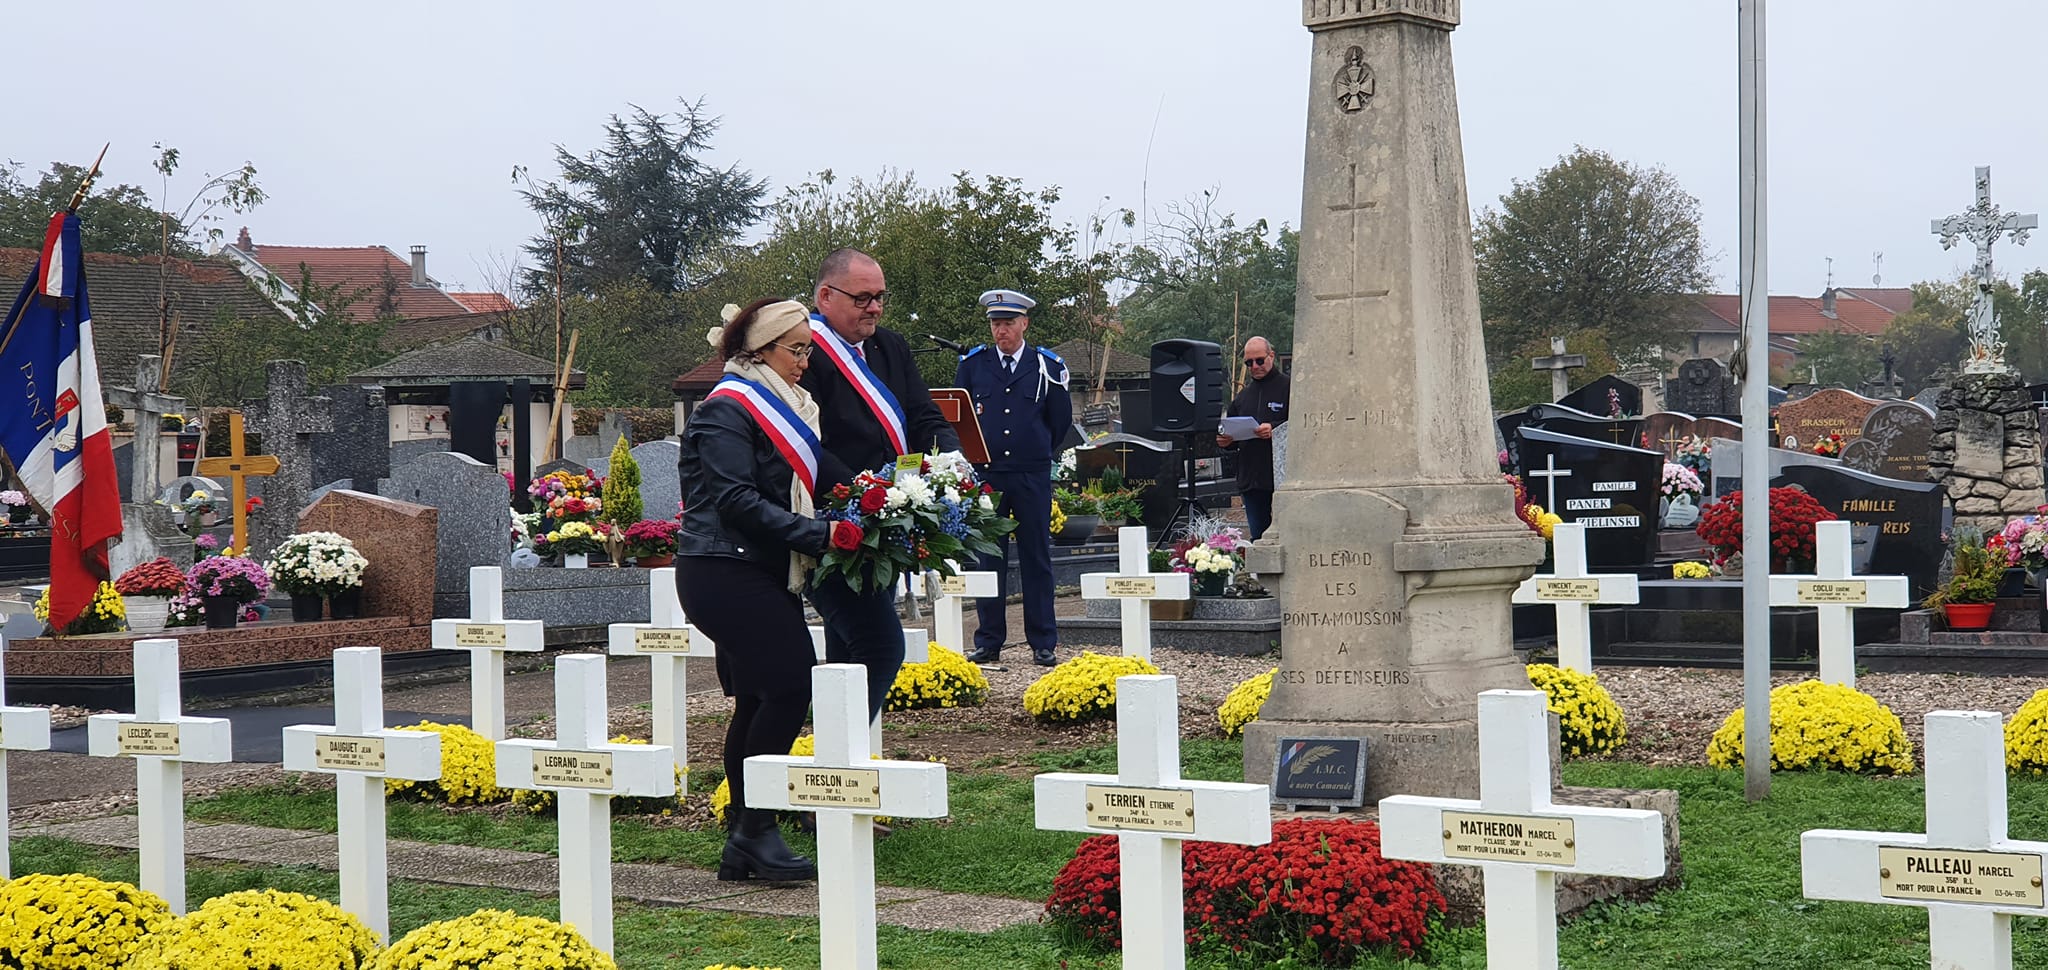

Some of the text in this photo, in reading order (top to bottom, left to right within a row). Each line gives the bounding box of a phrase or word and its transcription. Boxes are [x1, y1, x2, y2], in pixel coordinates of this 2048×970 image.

[20, 361, 53, 431] PONT
[1304, 412, 1336, 428] 1914
[1801, 418, 1846, 426] BRASSEUR
[1569, 500, 1608, 509] PANEK
[1842, 500, 1896, 512] FAMILLE
[1882, 521, 1910, 534] REIS
[1325, 582, 1357, 596] LES
[1338, 642, 1348, 655] A
[1280, 666, 1410, 685] SES DÉFENSEURS
[128, 728, 152, 738] LECLERC
[329, 741, 358, 752] DAUGUET
[544, 756, 578, 768] LEGRAND
[804, 774, 858, 788] FRESLON LÉON
[1104, 793, 1175, 810] TERRIEN ETIENNE
[1460, 820, 1558, 840] MATHERON MARCEL
[1456, 844, 1472, 852] MORT
[1474, 846, 1488, 854] POUR
[1498, 848, 1520, 856] FRANCE
[1906, 856, 2014, 878] PALLEAU MARCEL
[1896, 884, 1914, 892] MORT
[1917, 884, 1936, 894] POUR
[1947, 886, 1974, 895] FRANCE
